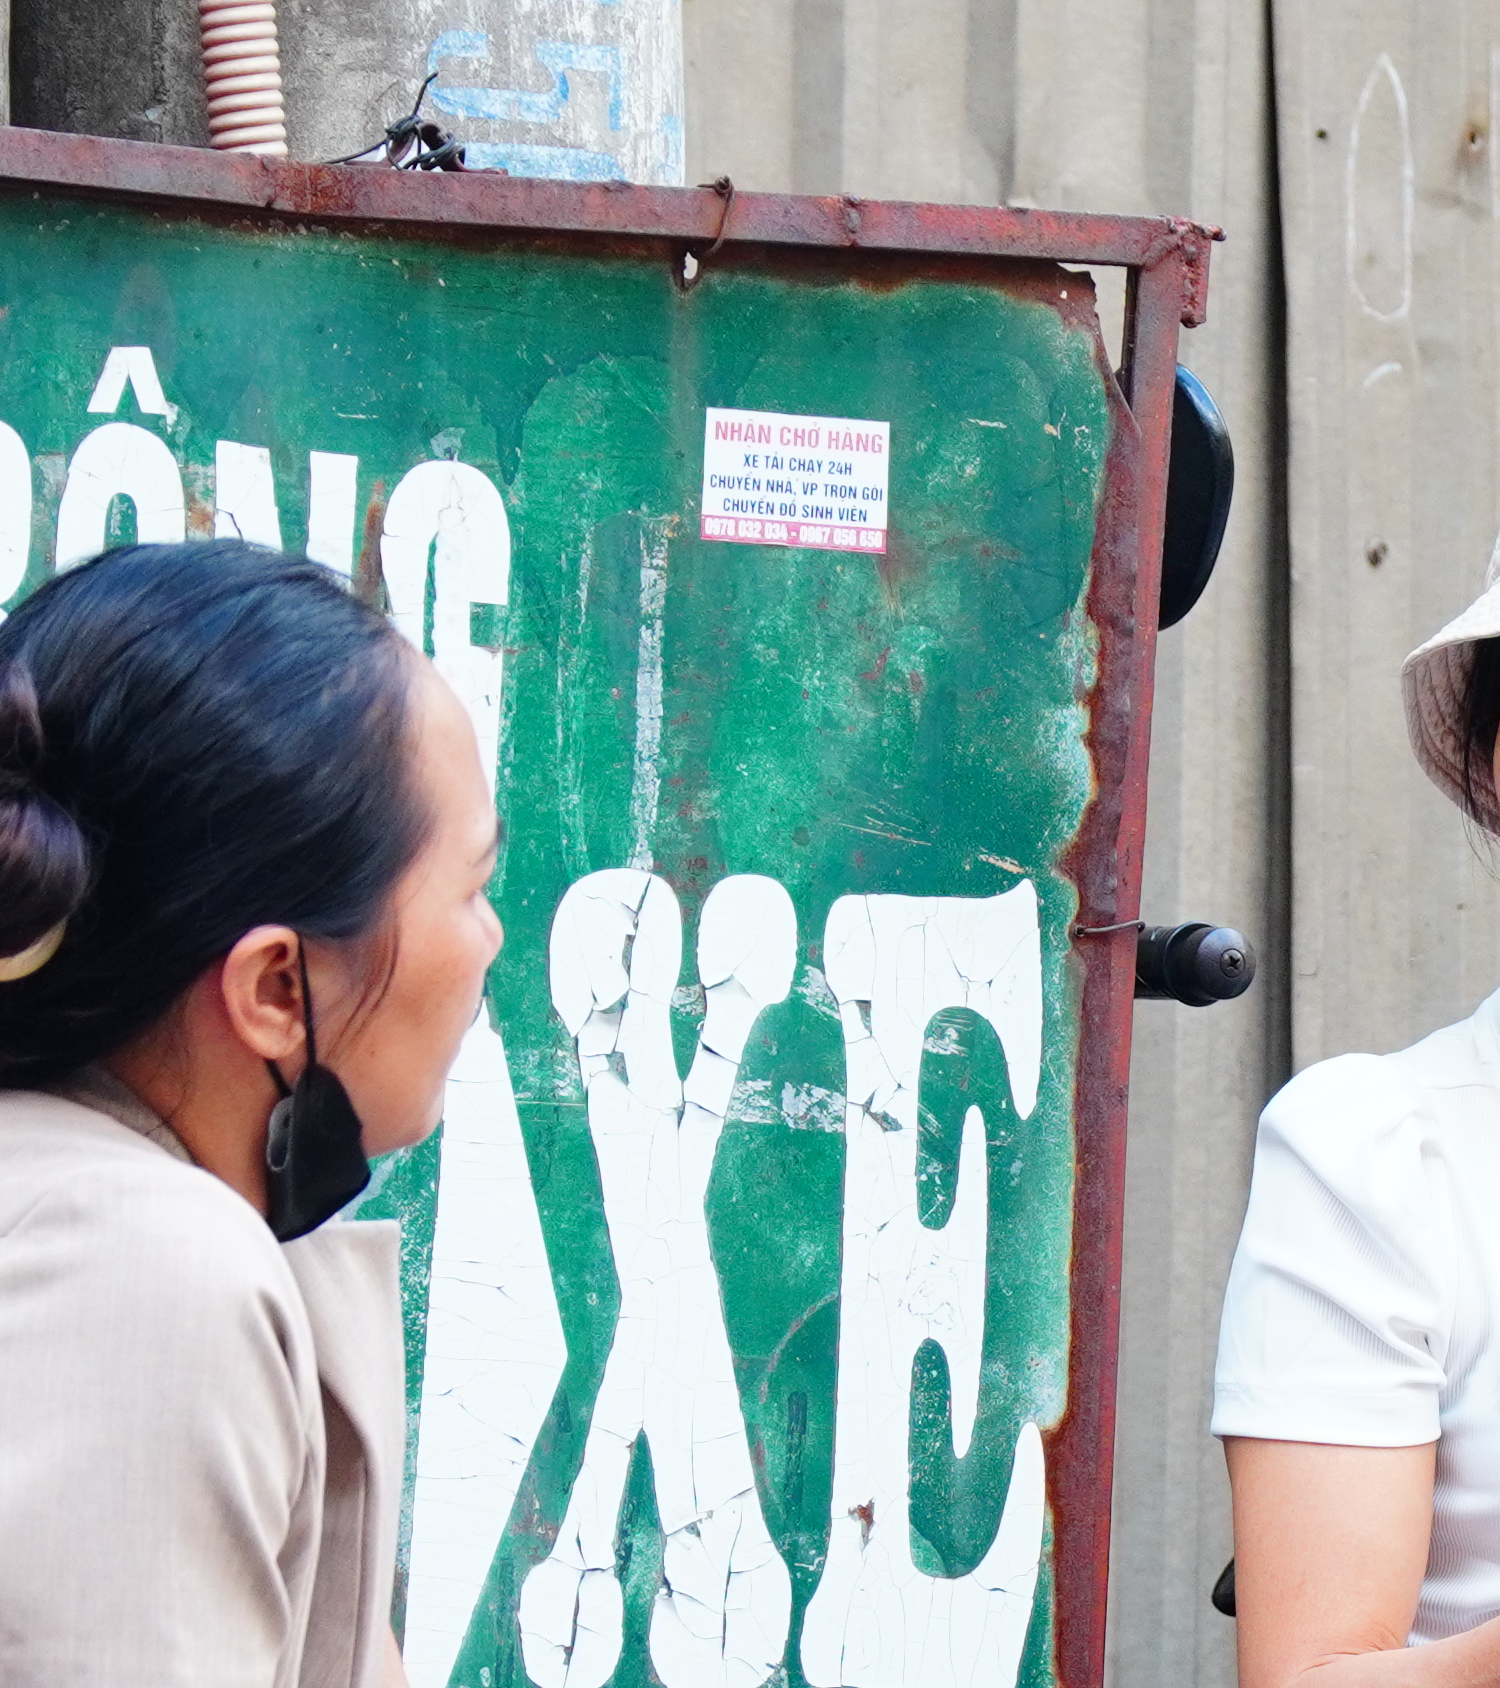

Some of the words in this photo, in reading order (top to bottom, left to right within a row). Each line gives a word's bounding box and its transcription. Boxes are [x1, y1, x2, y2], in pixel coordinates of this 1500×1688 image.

[715, 418, 772, 448] NHẬN
[779, 421, 821, 449] CHỞ
[828, 427, 883, 454] HÀNG
[743, 453, 759, 468] XE
[789, 457, 823, 477] CHẠY
[828, 460, 852, 476] 24H
[802, 481, 818, 496] VP
[823, 483, 857, 502] TRỌN
[802, 504, 833, 520] SINH
[838, 505, 868, 523] VIÊN
[737, 519, 763, 539] 032
[764, 521, 789, 541] 034
